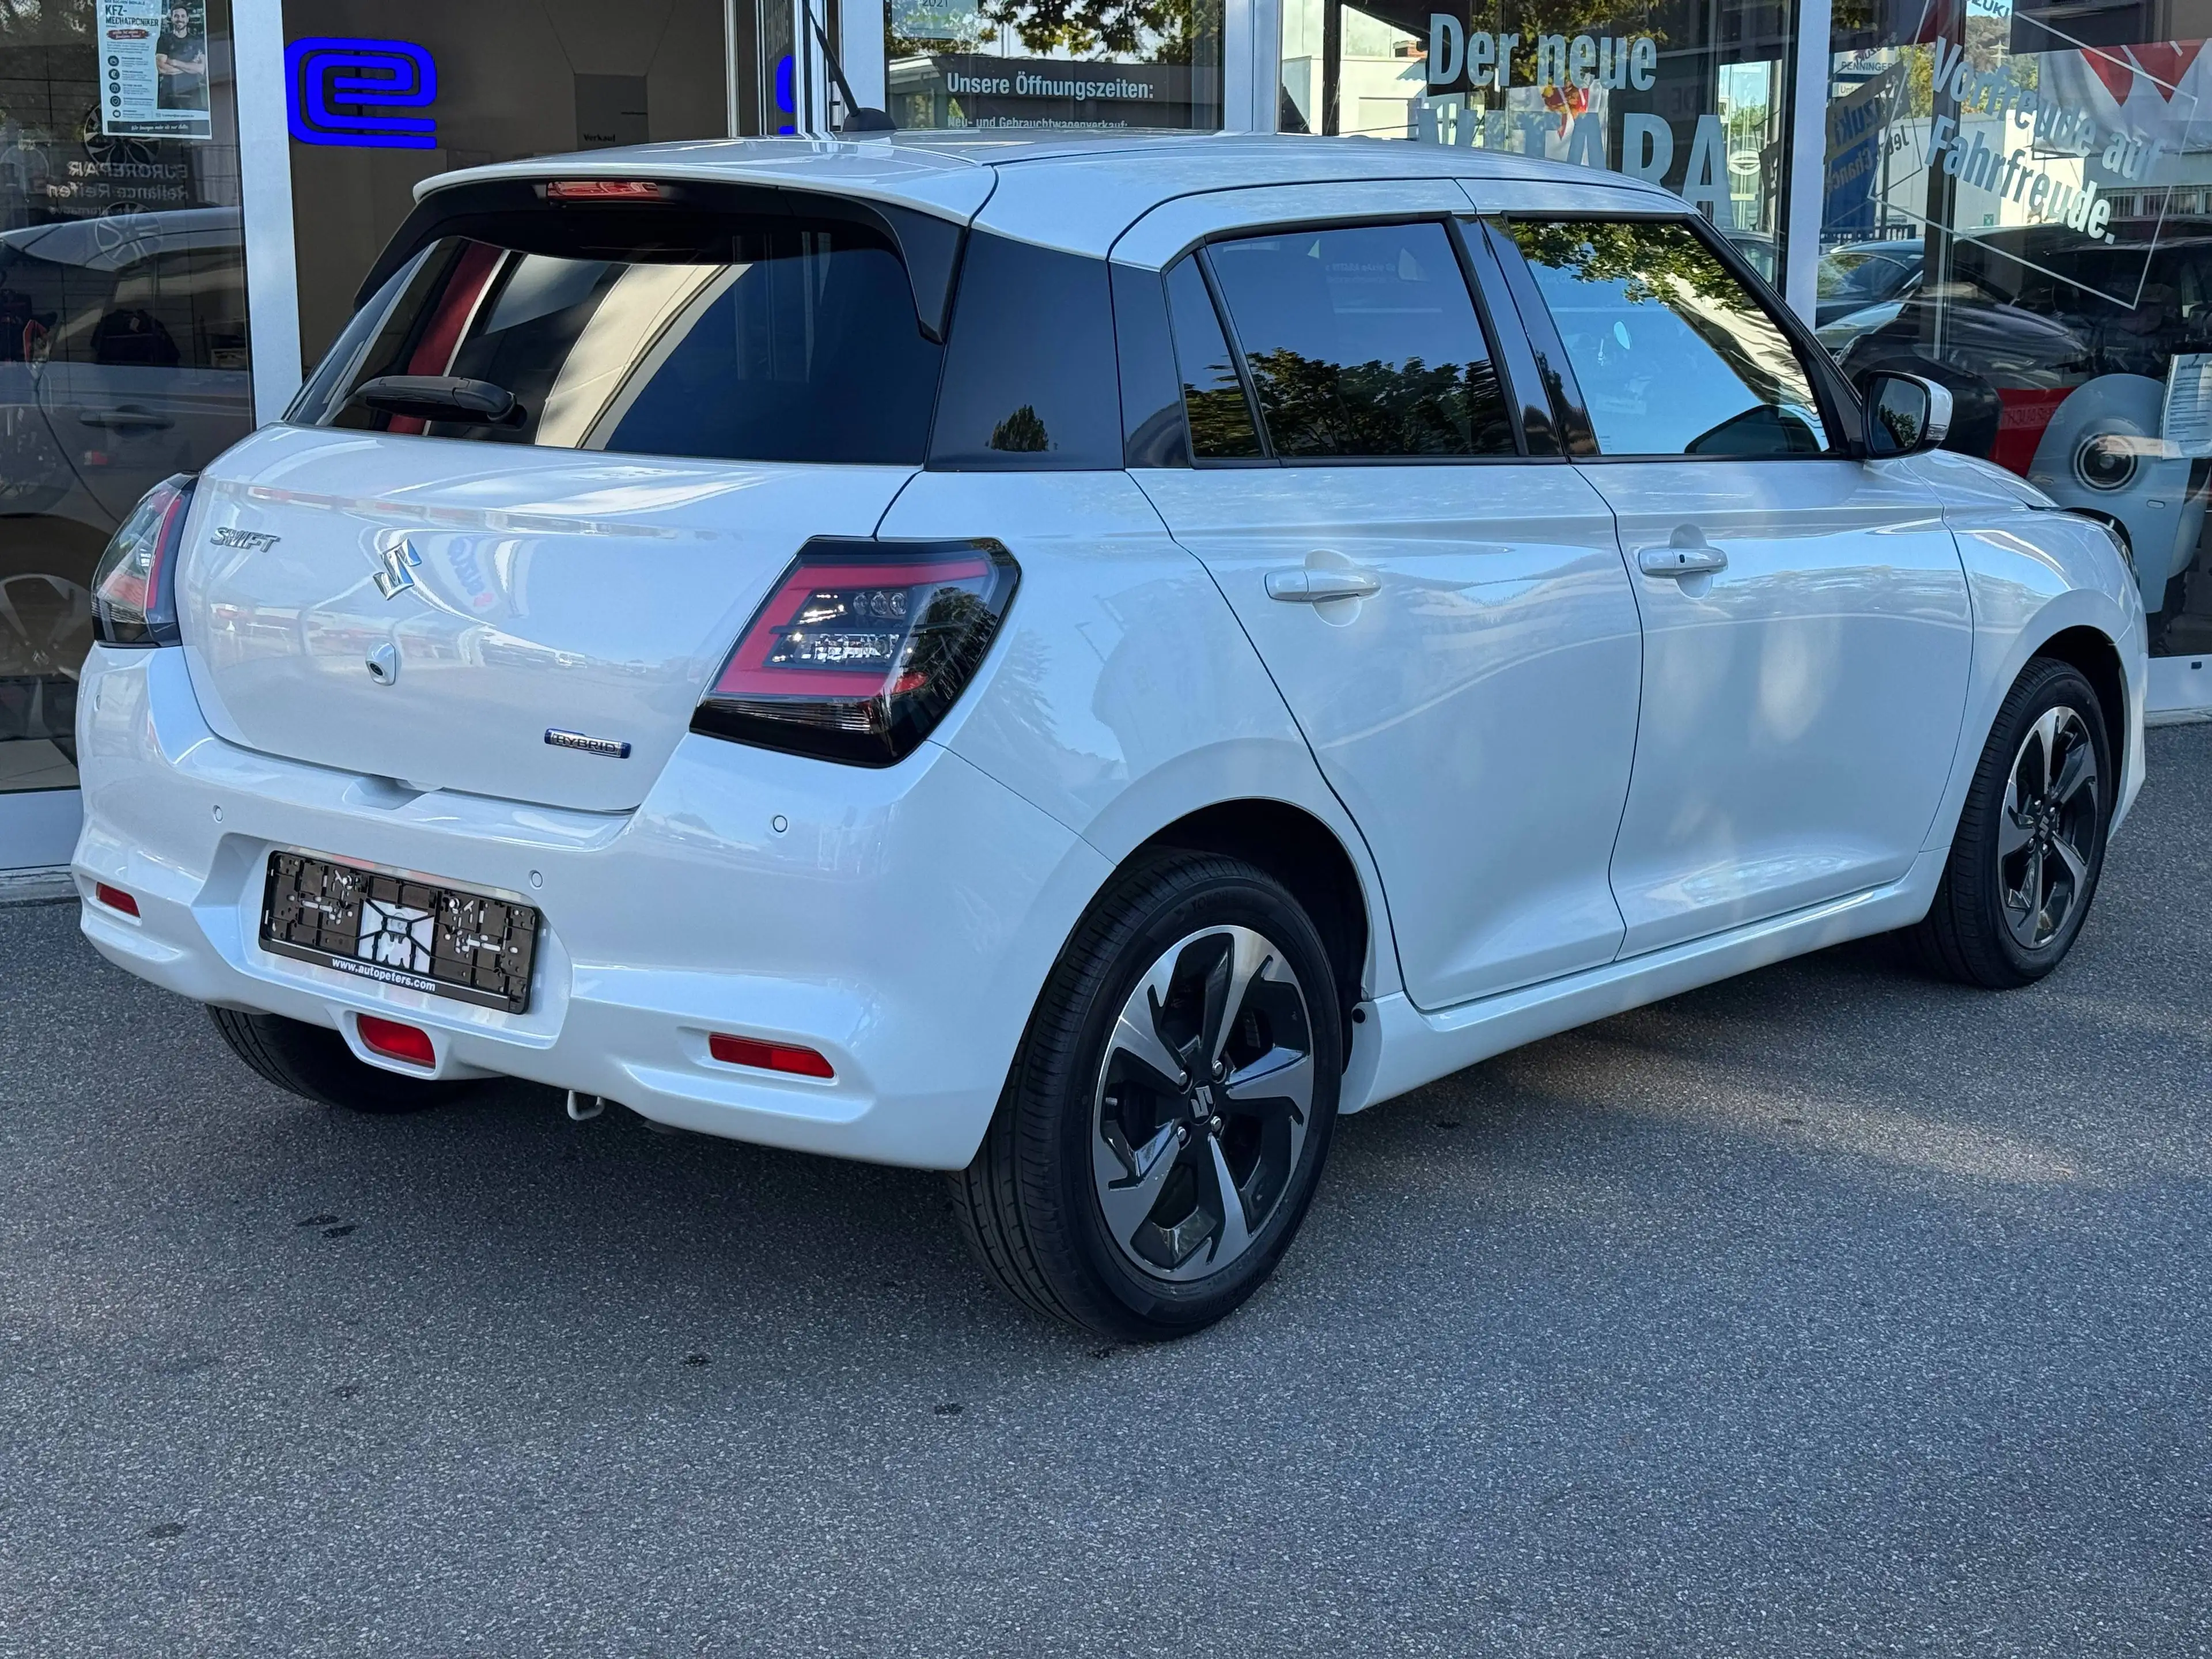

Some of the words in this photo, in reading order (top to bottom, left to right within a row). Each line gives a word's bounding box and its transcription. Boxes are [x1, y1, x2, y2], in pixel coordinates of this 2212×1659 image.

[105, 5, 127, 16] KFZ-
[1428, 13, 1519, 86] Der
[1537, 33, 1657, 92] neue
[947, 72, 1010, 93] Unsere
[1016, 71, 1154, 101] Öffnungszeiten:
[948, 115, 973, 127] Neu-
[976, 116, 995, 127] und
[1932, 35, 2097, 157] Vorfreude
[2101, 132, 2168, 181] auf
[1925, 113, 2115, 245] Fahrfreude.
[210, 526, 281, 553] SWIFT
[556, 733, 616, 752] HYBRID
[332, 958, 435, 992] www.autopeters.com
